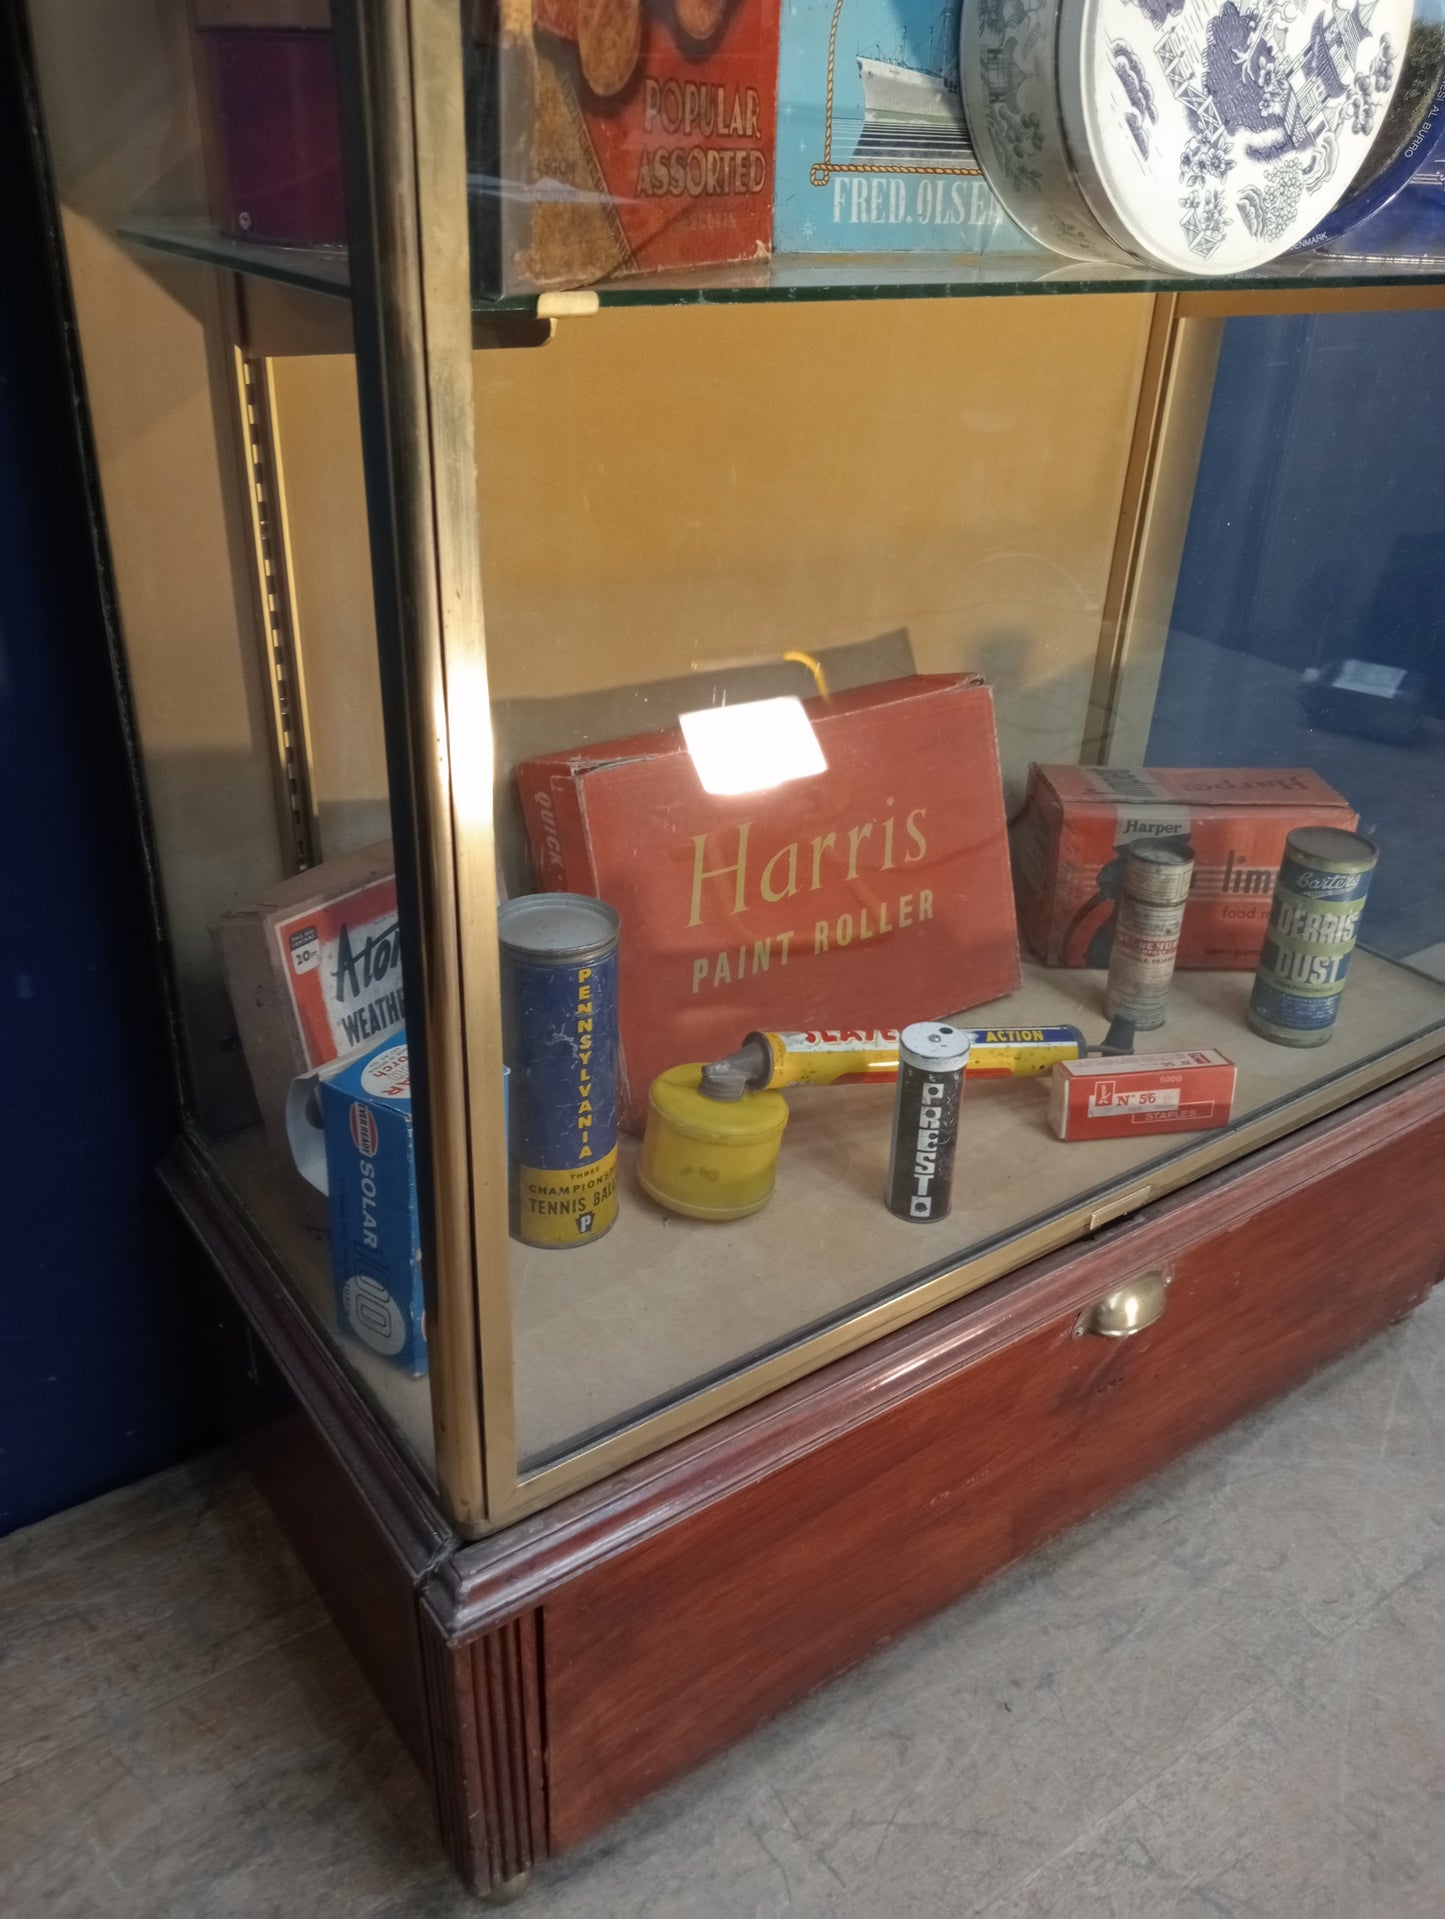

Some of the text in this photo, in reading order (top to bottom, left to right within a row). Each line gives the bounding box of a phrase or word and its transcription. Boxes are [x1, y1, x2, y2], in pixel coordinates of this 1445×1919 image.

[644, 77, 761, 139] POPULAR
[1427, 104, 1440, 119] AL
[1404, 121, 1432, 158] BURRO
[636, 144, 767, 197] ASSORTED
[535, 791, 564, 869] QUICK
[1122, 819, 1183, 835] Harper
[687, 796, 928, 928] Harris
[1222, 905, 1257, 919] food
[1277, 902, 1361, 944] DERRIS
[692, 888, 935, 995] PAINT ROLLER
[330, 921, 400, 1002] Ato
[1274, 950, 1345, 984] DUST
[986, 1030, 1045, 1043] ACTION
[372, 1056, 408, 1078] orch
[577, 967, 594, 1160] PENNSYLVANIA
[1159, 1074, 1183, 1084] 5000
[1138, 1092, 1157, 1105] 56
[1145, 1109, 1198, 1121] STAPLES
[360, 1125, 371, 1155] READY
[909, 1083, 945, 1218] PRESTO
[569, 1166, 601, 1180] THREE
[359, 1160, 379, 1250] SOLAR
[528, 1197, 587, 1216] TENNIS
